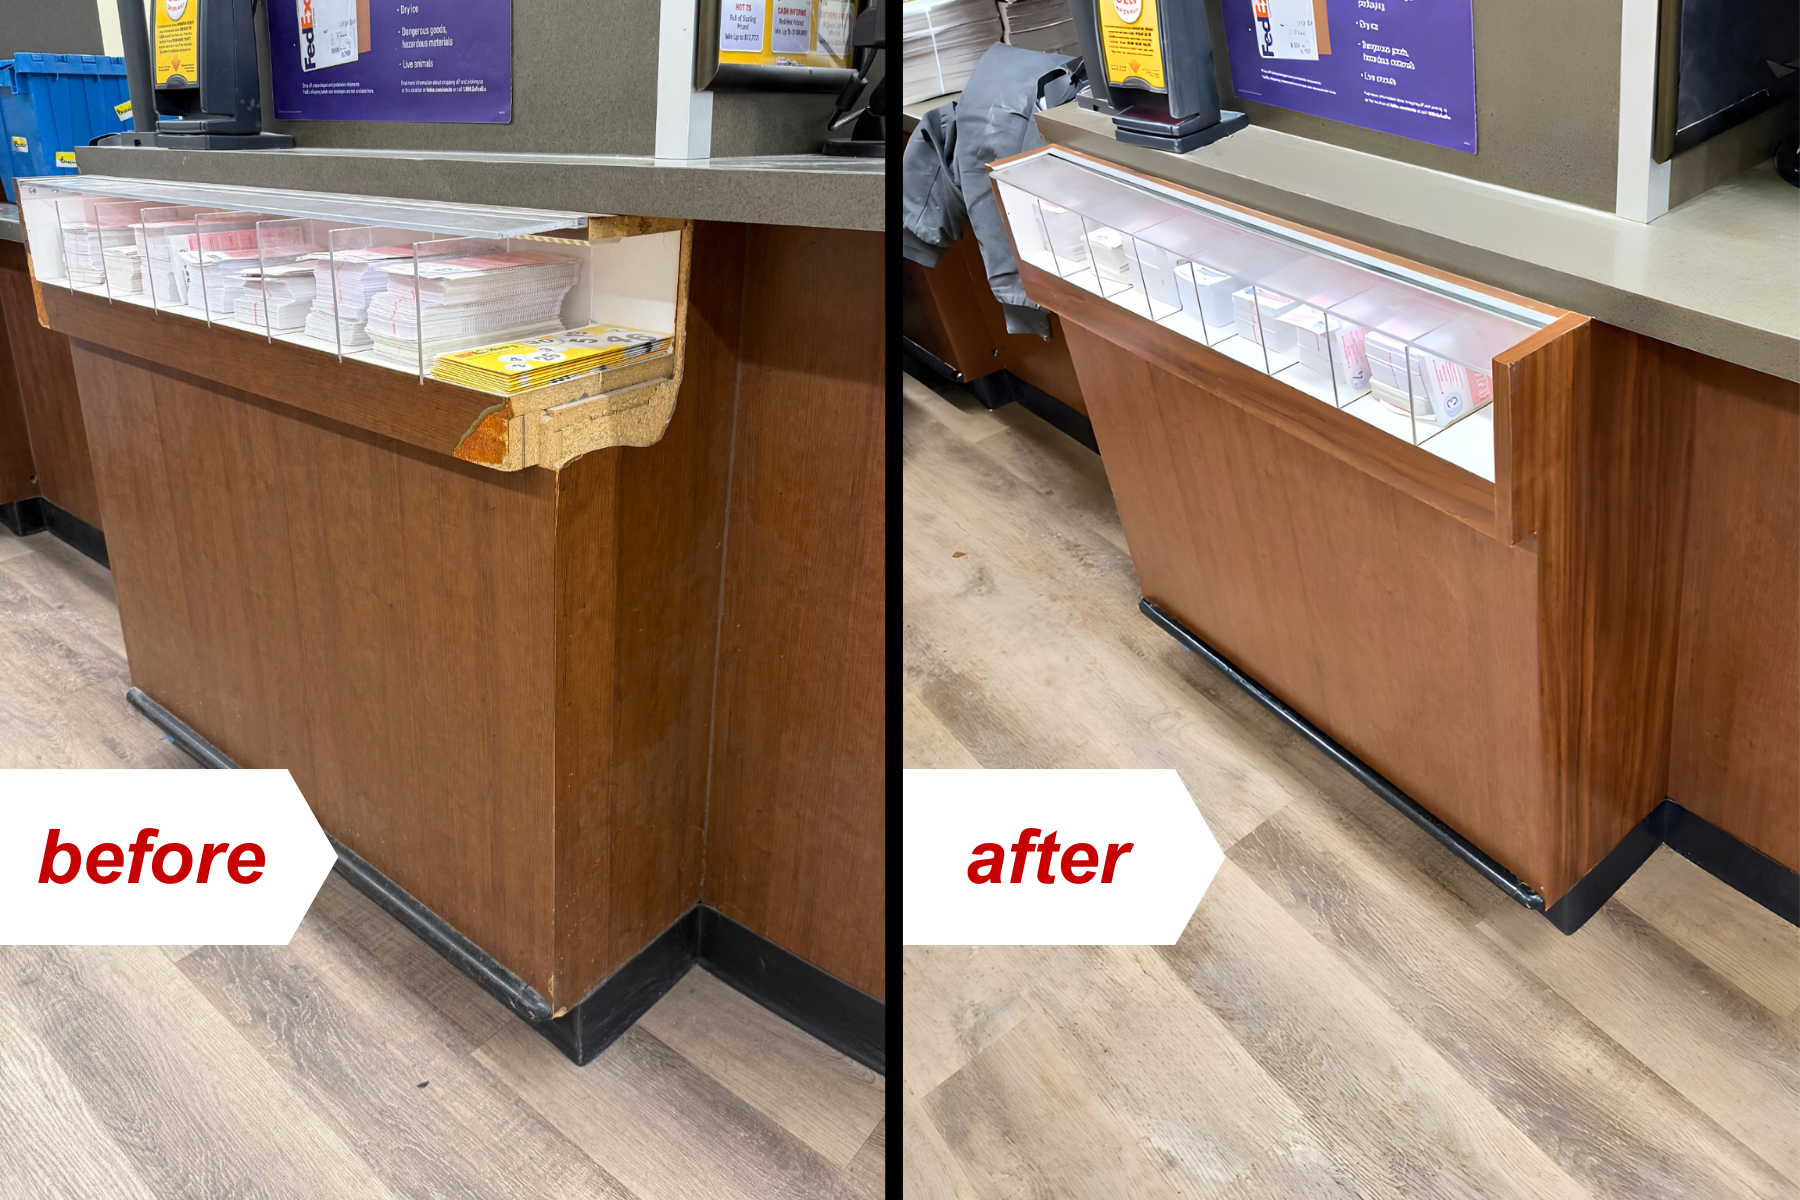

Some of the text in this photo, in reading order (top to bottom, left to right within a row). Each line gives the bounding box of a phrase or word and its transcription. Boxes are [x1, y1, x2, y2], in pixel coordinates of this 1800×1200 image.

[401, 4, 419, 15] Dry ice
[735, 3, 745, 11] HOT
[402, 24, 447, 37] Dangerous goods,
[402, 37, 453, 49] hazardous materials
[402, 59, 433, 69] Live animals
